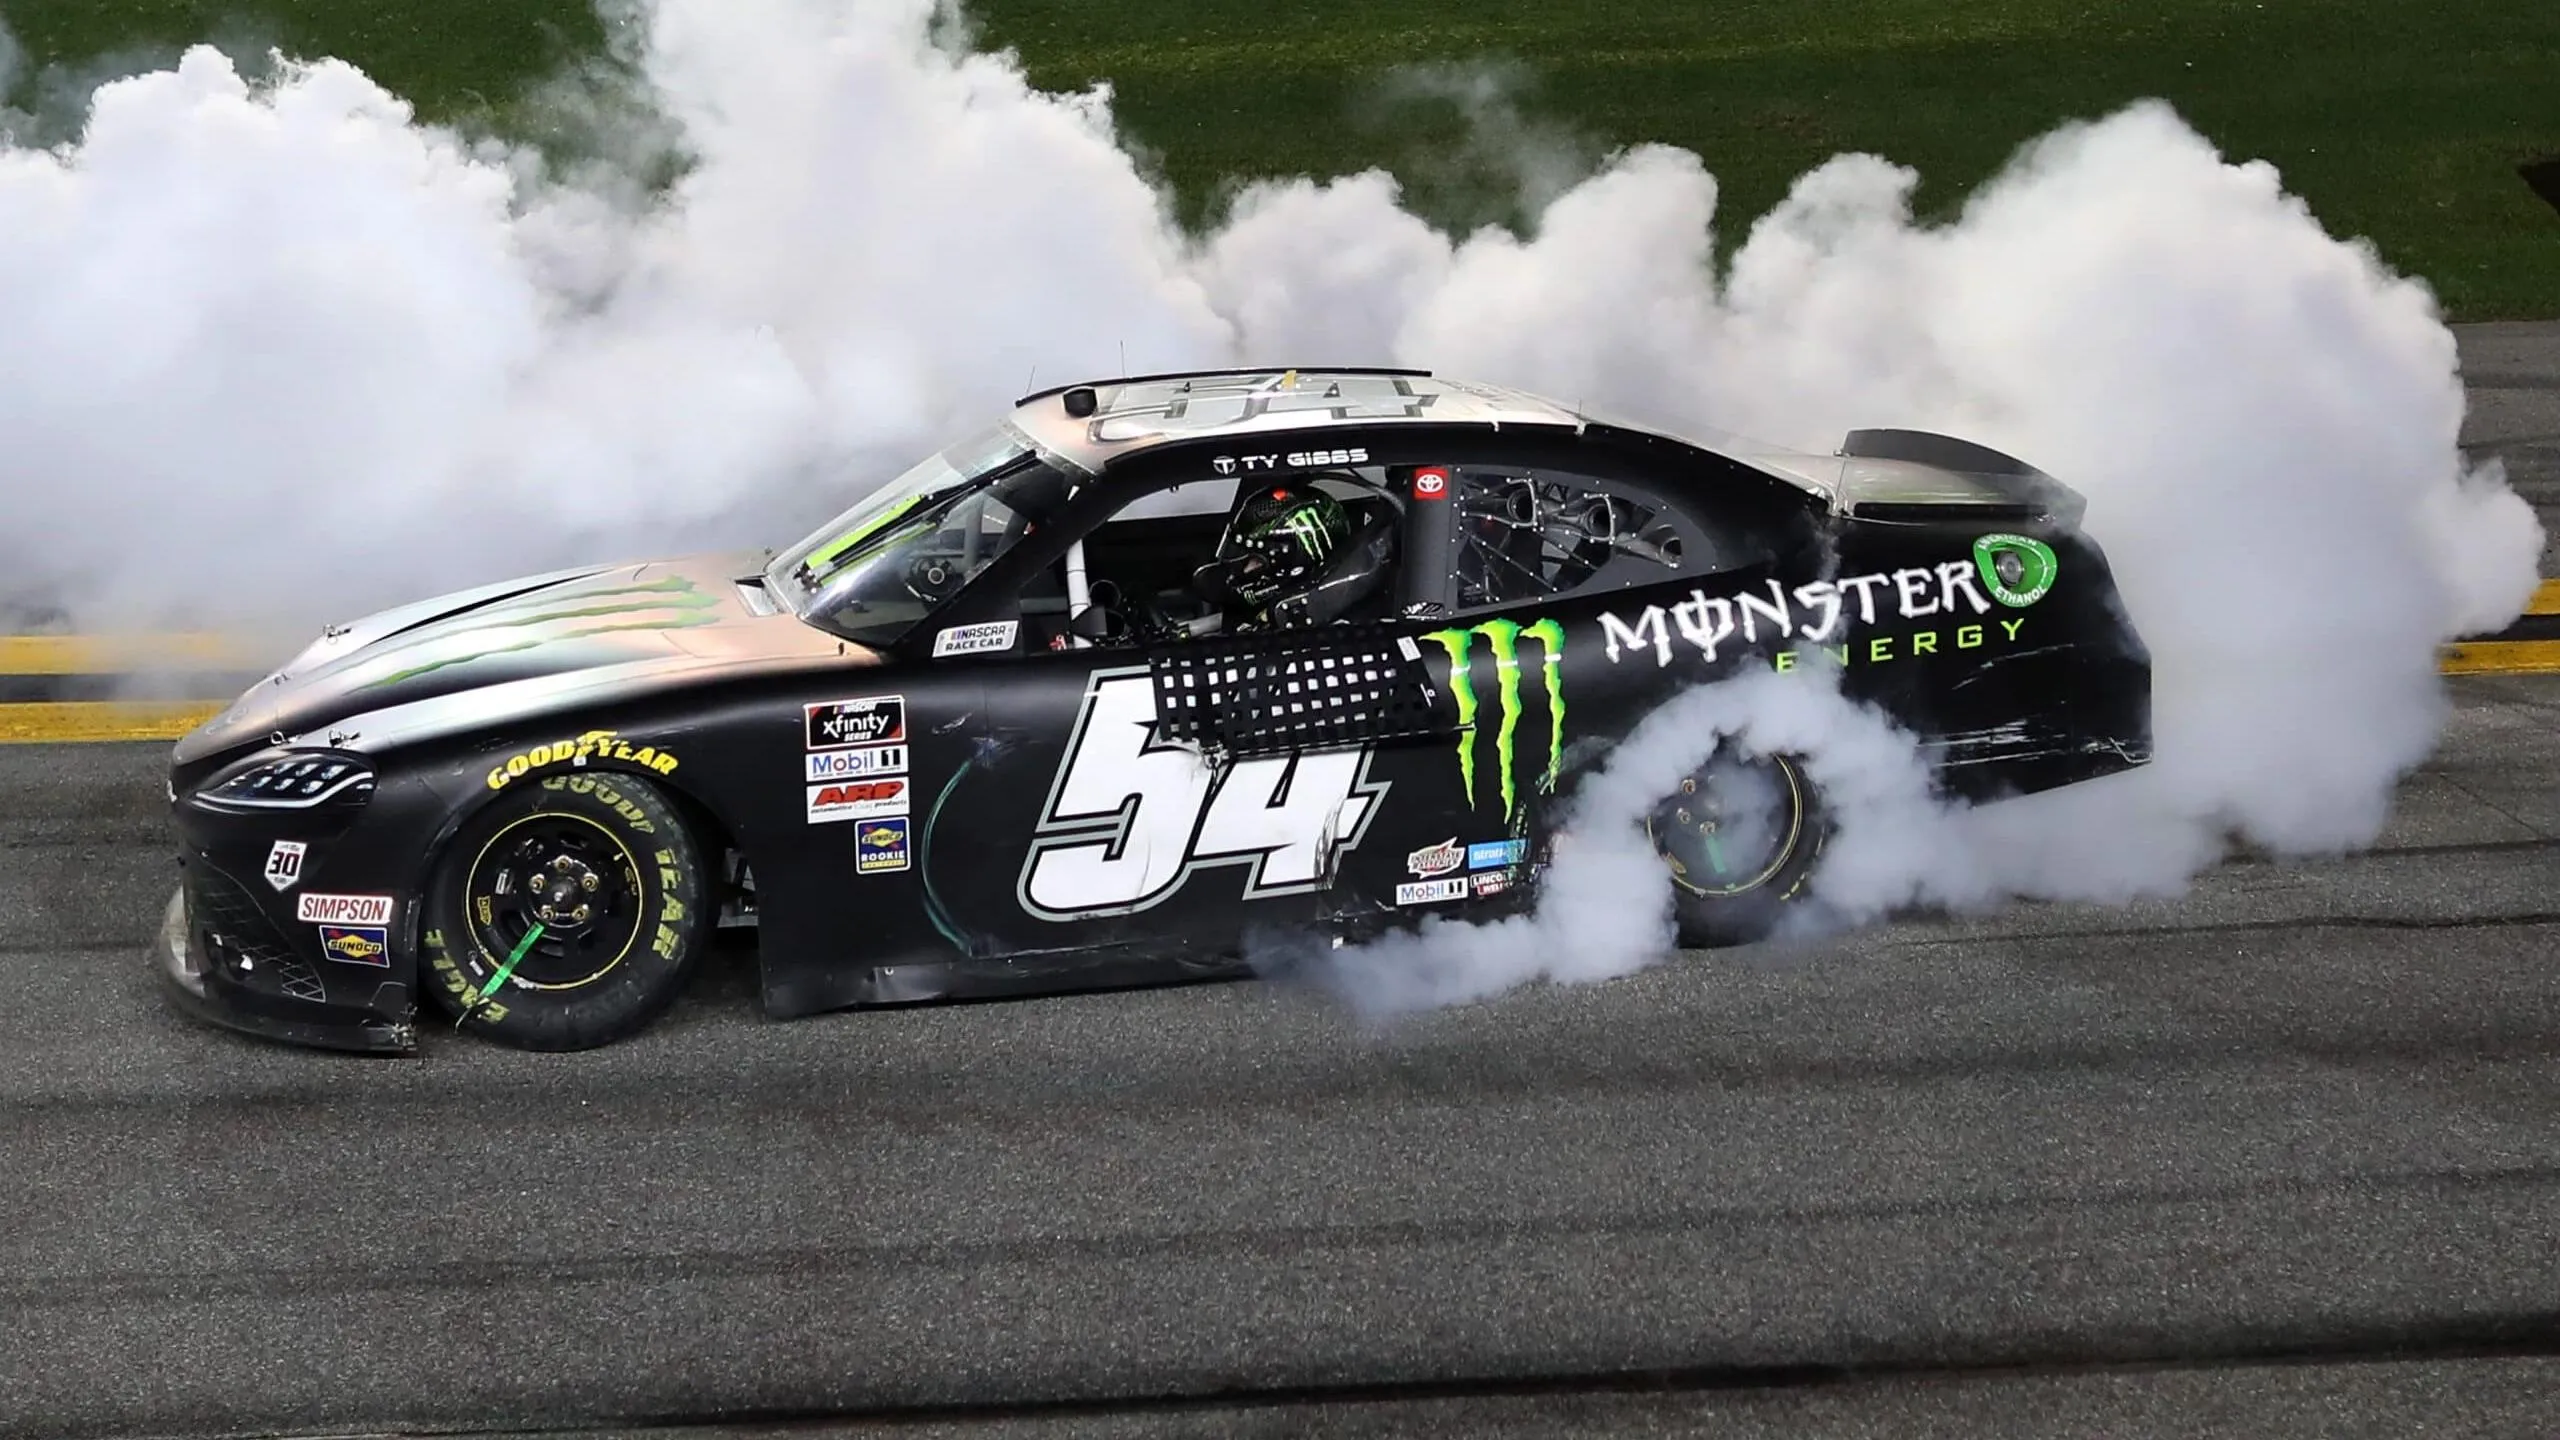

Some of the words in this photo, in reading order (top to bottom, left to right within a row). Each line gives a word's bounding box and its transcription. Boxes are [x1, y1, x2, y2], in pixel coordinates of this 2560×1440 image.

[1241, 454, 1278, 470] TY
[1287, 448, 1369, 467] GIBBS
[1994, 585, 2048, 604] ETHANOL
[1597, 560, 1991, 668] MONSTER
[945, 640, 977, 652] RACE
[979, 637, 1004, 648] CAR
[959, 625, 1007, 640] NASCAR
[823, 713, 889, 738] xfinity
[487, 731, 679, 790] GOODYEAR
[812, 750, 875, 775] Mobil
[883, 749, 900, 767] 1
[812, 780, 905, 807] ARP
[1016, 664, 1392, 923] 54
[267, 850, 300, 877] 30
[861, 850, 905, 863] ROOKIE
[1400, 882, 1445, 902] Mobil
[302, 897, 387, 921] SIMPSON
[328, 940, 381, 953] SUNOCO
